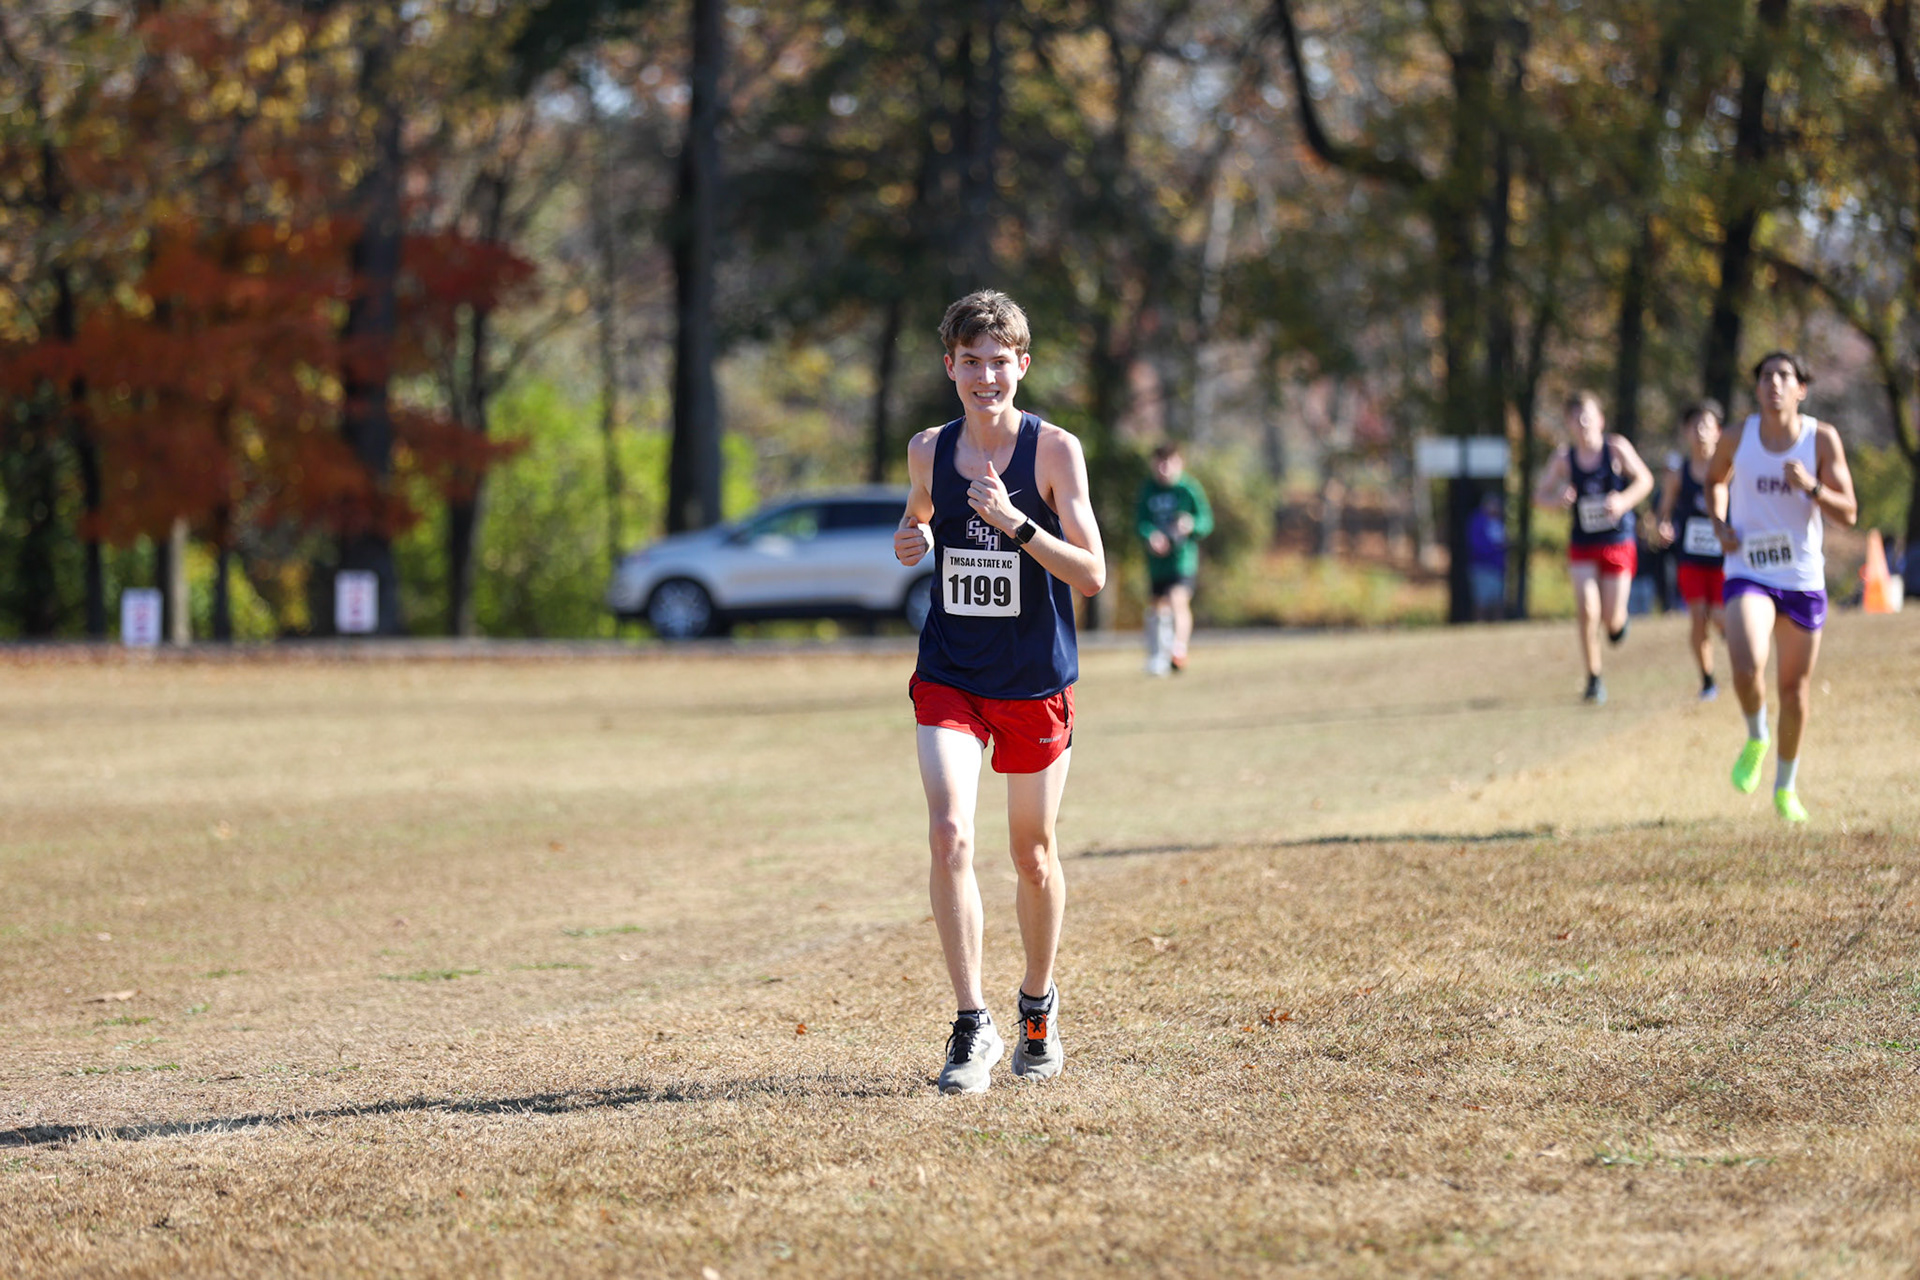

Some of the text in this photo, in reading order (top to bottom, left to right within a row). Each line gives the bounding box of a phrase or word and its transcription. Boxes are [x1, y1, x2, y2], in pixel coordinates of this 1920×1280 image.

[968, 520, 999, 550] SBA
[950, 556, 1013, 569] TMSAA STATE XC
[1748, 546, 1792, 568] 1068
[948, 574, 1011, 606] 1199
